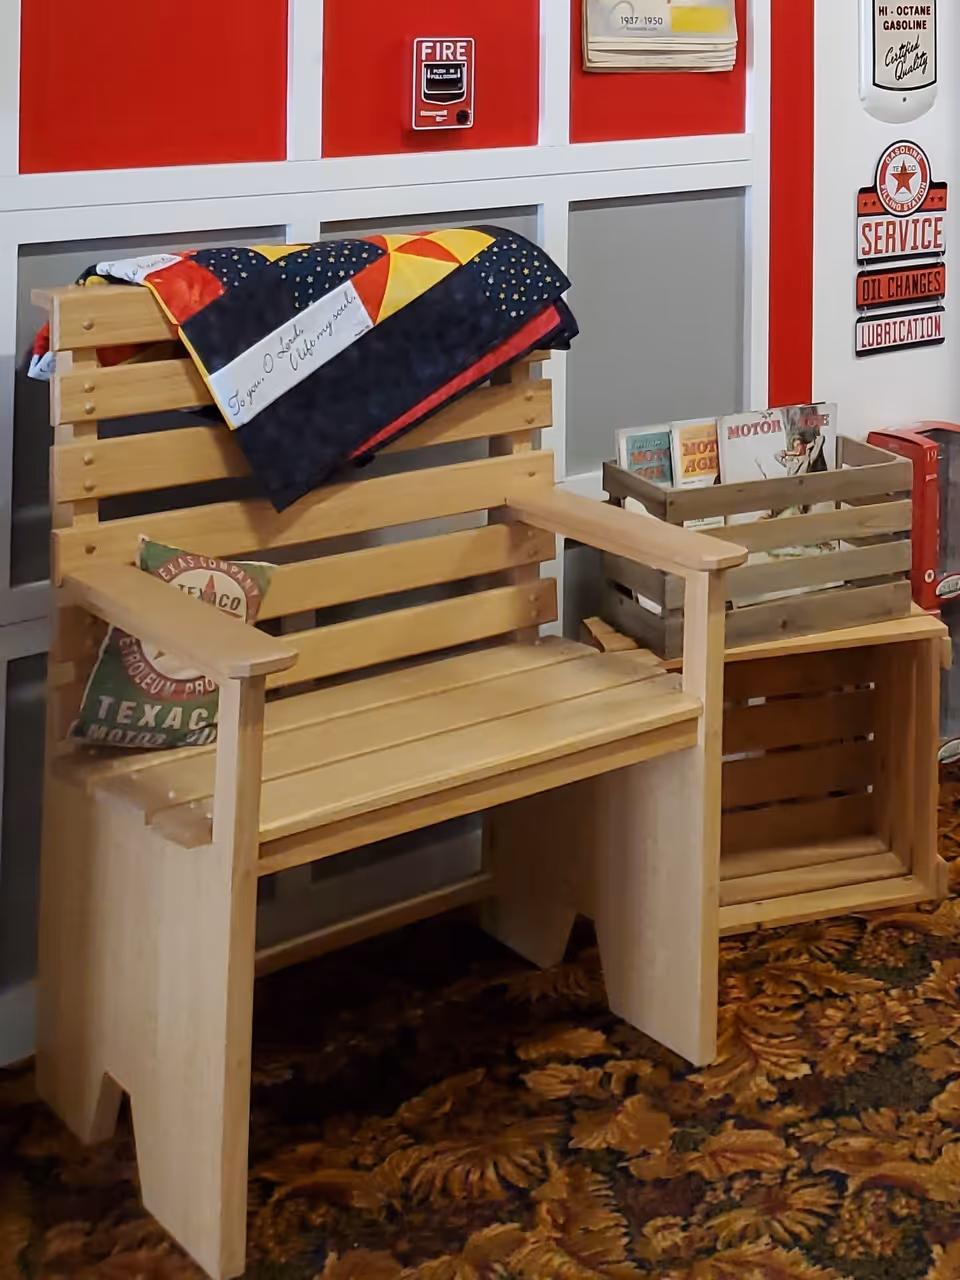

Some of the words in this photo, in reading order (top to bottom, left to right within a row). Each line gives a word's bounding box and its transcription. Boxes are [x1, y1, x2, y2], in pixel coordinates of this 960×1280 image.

[878, 6, 888, 16] HI
[896, 6, 931, 16] OCTANE
[883, 20, 927, 31] GASOLINE
[421, 42, 467, 60] FIRE
[884, 34, 920, 67] Certified
[894, 52, 928, 81] Quality
[885, 146, 922, 165] GASOLINE
[880, 183, 902, 211] FILLING
[903, 181, 927, 212] STATION
[861, 216, 943, 256] SERVICE
[862, 279, 883, 301] OIL
[887, 271, 942, 299] CHANGES
[316, 319, 333, 341] my
[860, 315, 942, 349] LUBRICATION
[228, 388, 245, 417] To
[262, 352, 274, 374] O
[727, 419, 782, 440] MOTOR
[926, 451, 937, 462] 19
[200, 556, 260, 597] COMPANY
[98, 694, 218, 732] TEXAC
[85, 723, 167, 747] MOTOR
